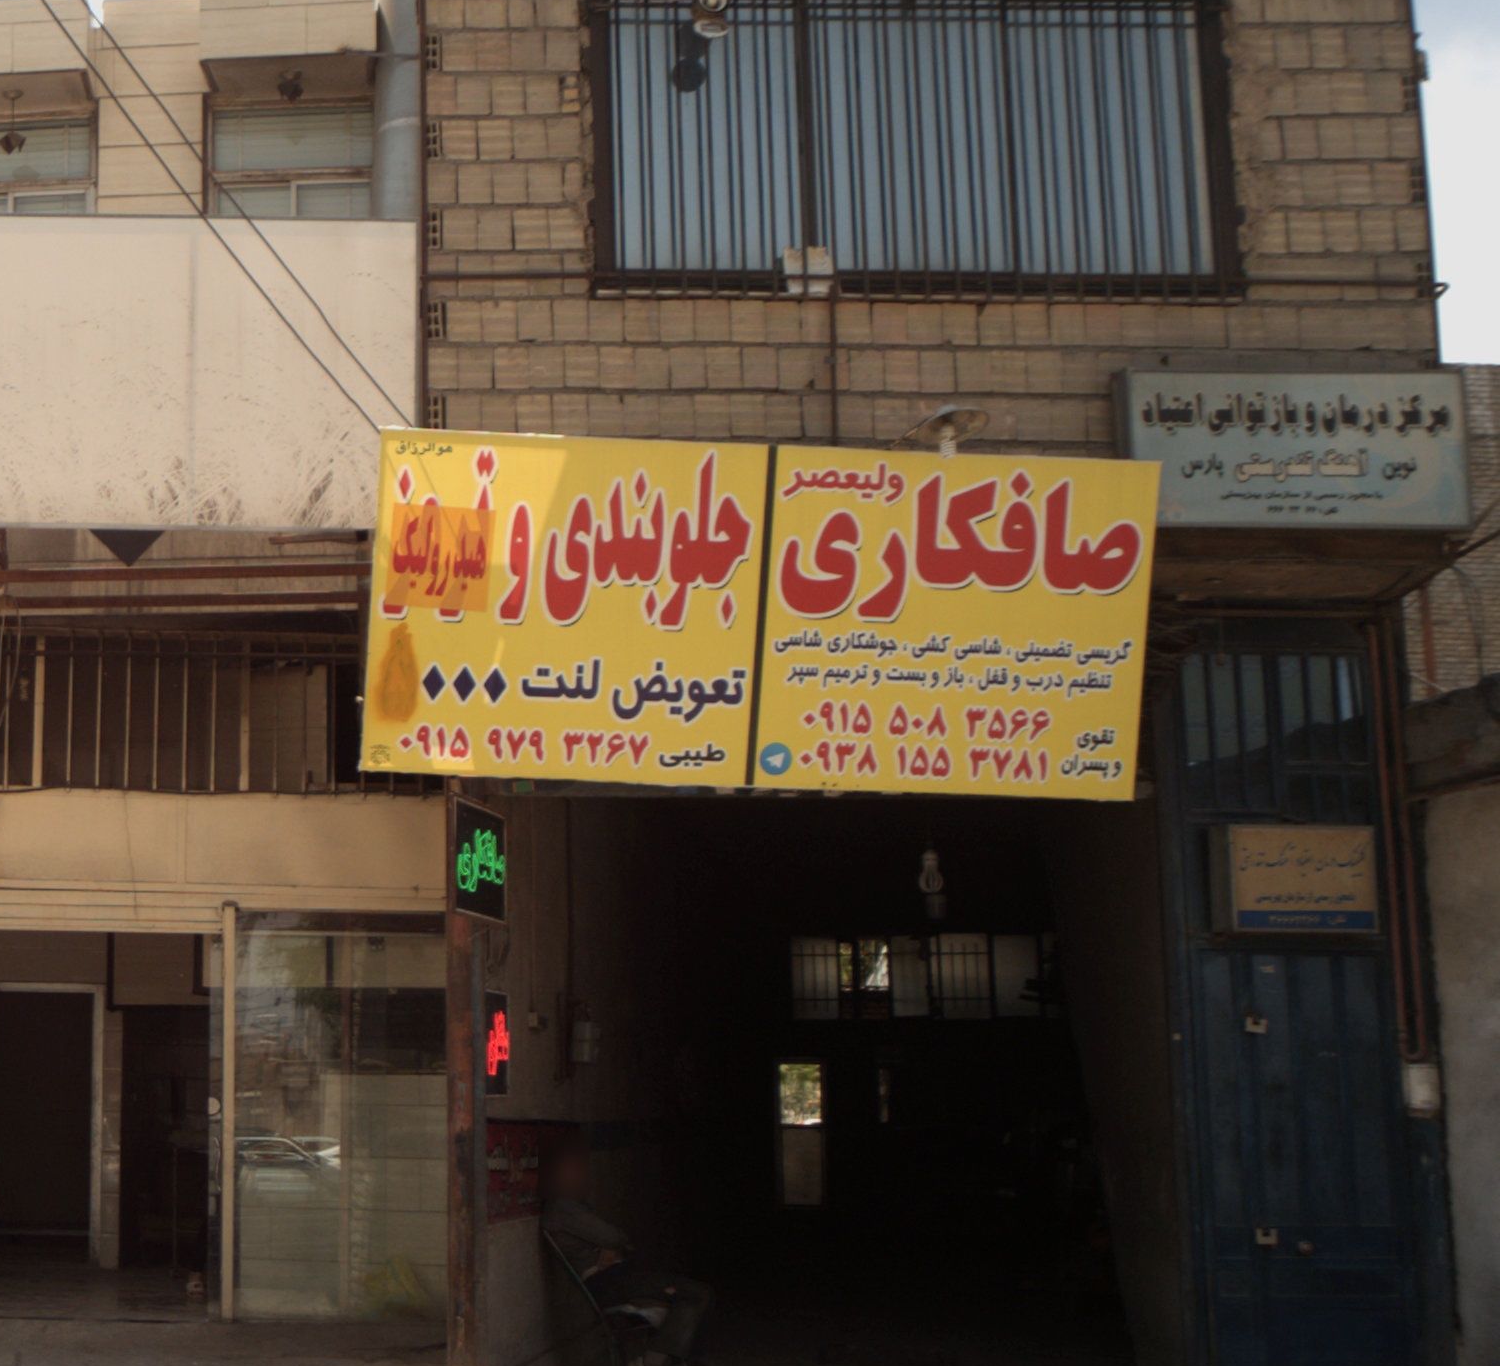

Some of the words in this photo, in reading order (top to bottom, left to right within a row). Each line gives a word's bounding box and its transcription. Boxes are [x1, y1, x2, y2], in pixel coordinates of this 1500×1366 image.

[1142, 393, 1203, 432] اعتیاد
[1306, 402, 1316, 433] و
[1322, 394, 1388, 433] درمان
[1396, 394, 1449, 433] مرکز
[1182, 454, 1224, 479] پارس
[782, 463, 905, 503] ولیعصر
[543, 450, 752, 629] جلوبندی
[780, 471, 1141, 622] صافکاری
[393, 515, 487, 596] هیدرولیک
[500, 503, 531, 621] و
[774, 630, 822, 652] شاسی
[827, 632, 897, 658] جوشکاری
[912, 635, 951, 658] کشی
[955, 638, 1001, 659] شاسی
[521, 658, 601, 699] لنت
[787, 665, 819, 684] سپر
[823, 665, 868, 688] ترمیم
[872, 669, 881, 686] و
[886, 667, 926, 687] بست
[931, 671, 940, 688] و
[945, 667, 964, 689] باز
[979, 668, 1008, 691] قفل
[1012, 674, 1021, 692] و
[1026, 673, 1063, 691] درب
[1069, 672, 1112, 697] تنظیم
[612, 662, 747, 722] تعویض
[802, 701, 873, 735] ۰۹۱۵
[889, 705, 948, 737] ۵۰۸
[965, 708, 1051, 741] ۳۵۶۶
[399, 725, 470, 759] ۰۹۱۵
[487, 727, 544, 761] ۹۷۹
[562, 731, 650, 765] ۳۲۶۷
[659, 743, 726, 768] طیبی
[800, 741, 878, 774] ۰۹۳۸
[898, 745, 951, 777] ۱۵۵
[969, 748, 1049, 781] ۳۷۸۱
